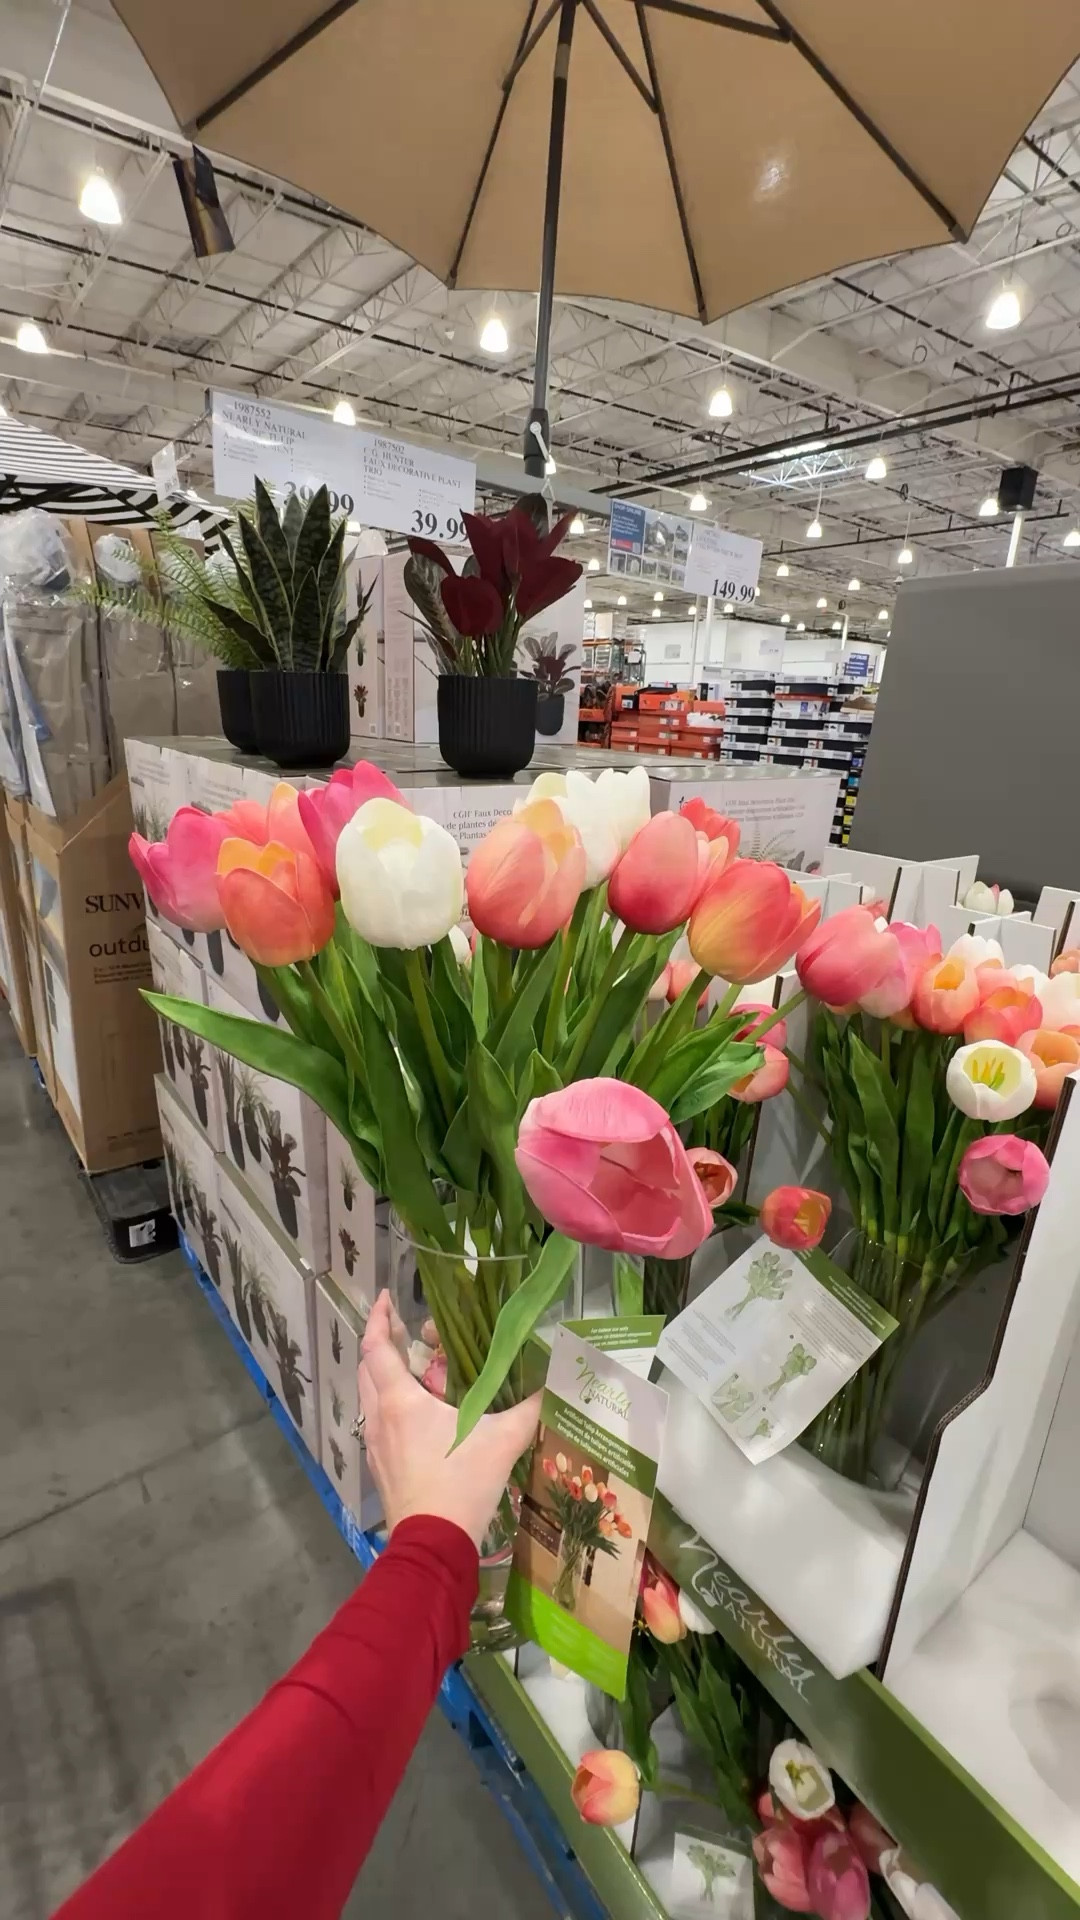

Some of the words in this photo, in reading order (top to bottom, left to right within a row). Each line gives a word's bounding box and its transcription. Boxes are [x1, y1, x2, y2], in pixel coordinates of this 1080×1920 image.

[234, 401, 271, 419] 1987552
[222, 409, 260, 427] NEARLY
[264, 421, 305, 439] NATURAL
[387, 462, 436, 481] DECORATIVE
[438, 475, 461, 489] PLANT
[713, 579, 755, 603] 149.99
[458, 820, 487, 831] plantes
[474, 810, 491, 818] Faux
[459, 832, 487, 840] Plantas
[588, 1388, 629, 1421] NATURAL
[595, 1429, 628, 1456] Arrangement
[710, 1579, 810, 1704] NATURAL
